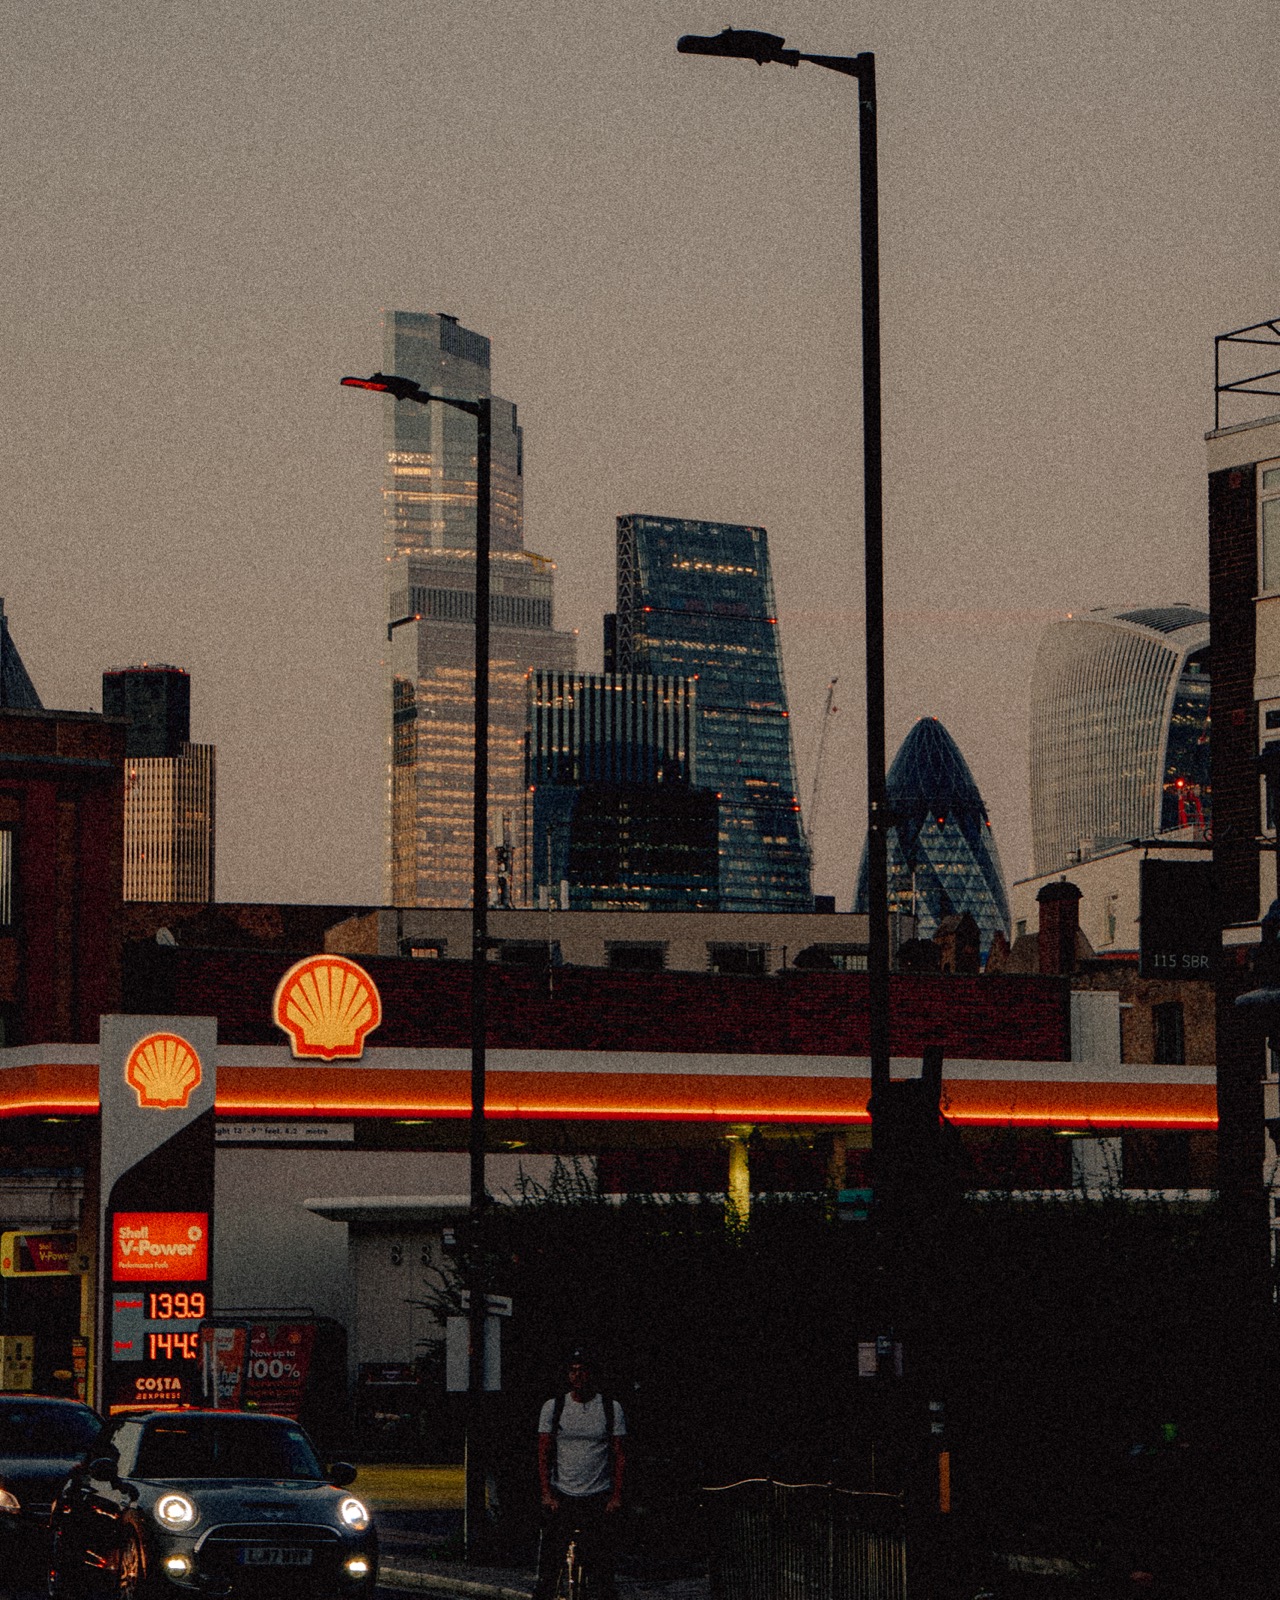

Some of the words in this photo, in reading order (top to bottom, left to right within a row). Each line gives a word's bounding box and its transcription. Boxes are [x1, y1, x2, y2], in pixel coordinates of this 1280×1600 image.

[1154, 953, 1177, 968] 115
[1182, 954, 1210, 969] SBR
[119, 1226, 149, 1239] Shell
[119, 1239, 197, 1256] V-Power
[250, 1349, 272, 1357] Now
[273, 1351, 285, 1359] up
[286, 1350, 296, 1358] to
[248, 1359, 301, 1379] 100%
[136, 1377, 182, 1391] COSTA
